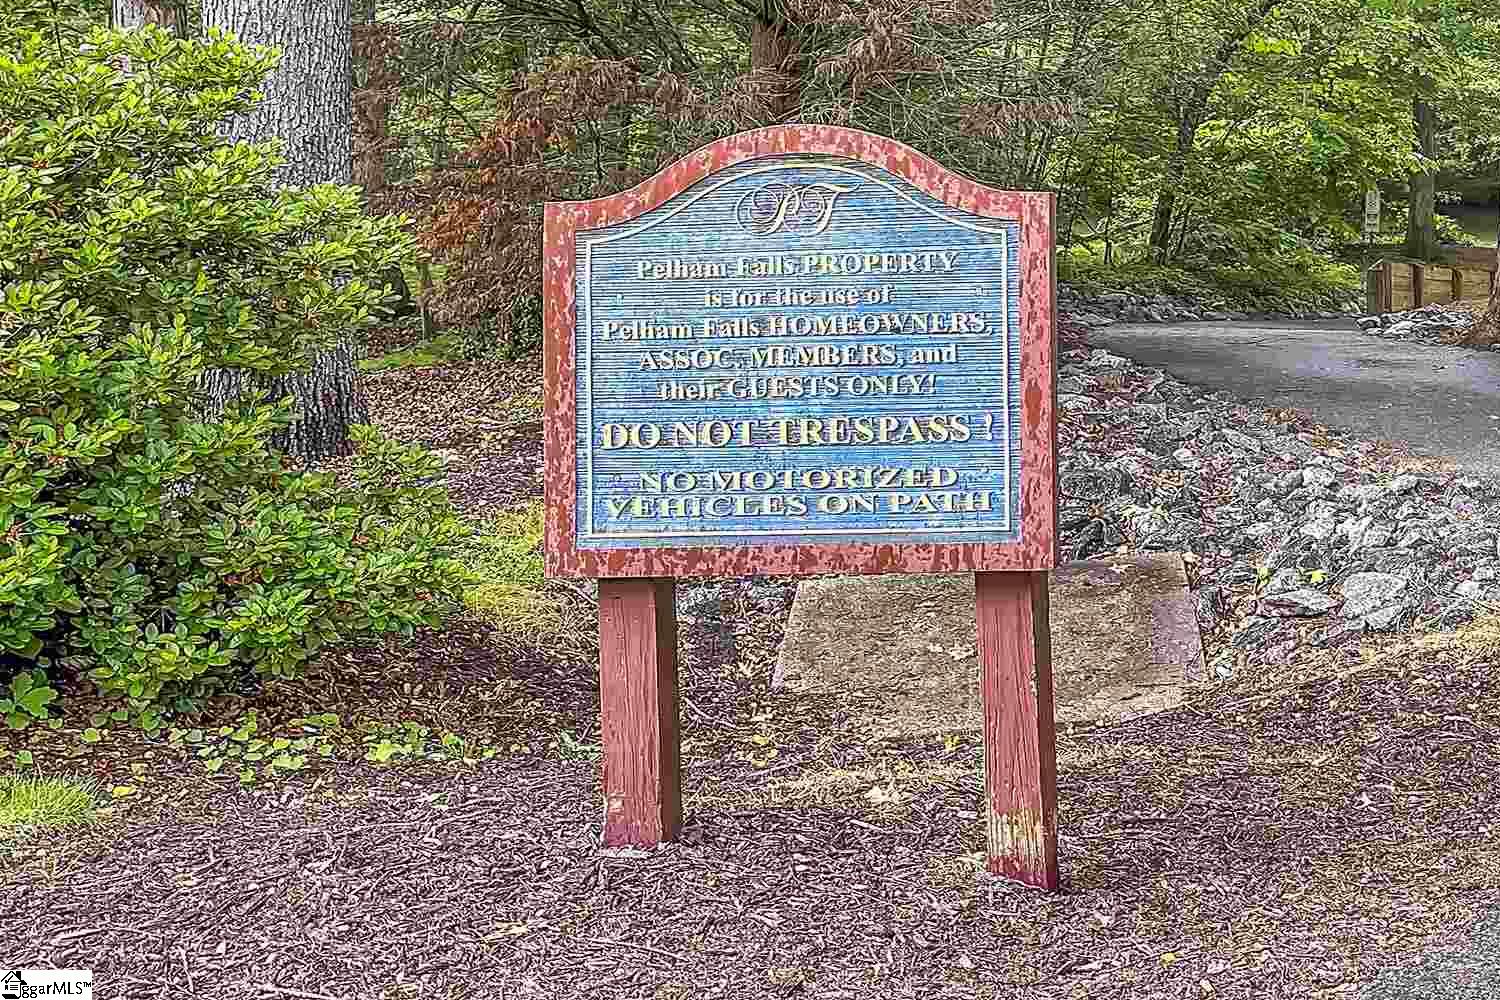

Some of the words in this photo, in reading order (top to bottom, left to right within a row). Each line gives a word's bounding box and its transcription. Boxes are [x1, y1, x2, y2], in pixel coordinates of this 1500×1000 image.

[637, 257, 728, 280] Pelham
[736, 255, 793, 277] Falls
[804, 250, 959, 275] PROPERTY
[704, 291, 720, 307] is
[735, 288, 763, 306] for
[774, 287, 813, 305] the
[821, 289, 860, 304] use
[865, 283, 894, 304] of
[602, 318, 694, 341] Pelham
[704, 316, 762, 337] Falls
[911, 343, 957, 363] and
[659, 378, 718, 400] their
[727, 376, 840, 398] GUESTS
[848, 374, 936, 396] ONLY!
[603, 422, 661, 449] DO
[672, 419, 755, 447] NOT
[777, 414, 972, 444] TRESPASS
[640, 471, 697, 491] NO
[712, 467, 958, 490] MOTORIZED
[606, 497, 808, 518] VEHICLES
[818, 495, 879, 515] ON
[889, 491, 992, 512] PATH
